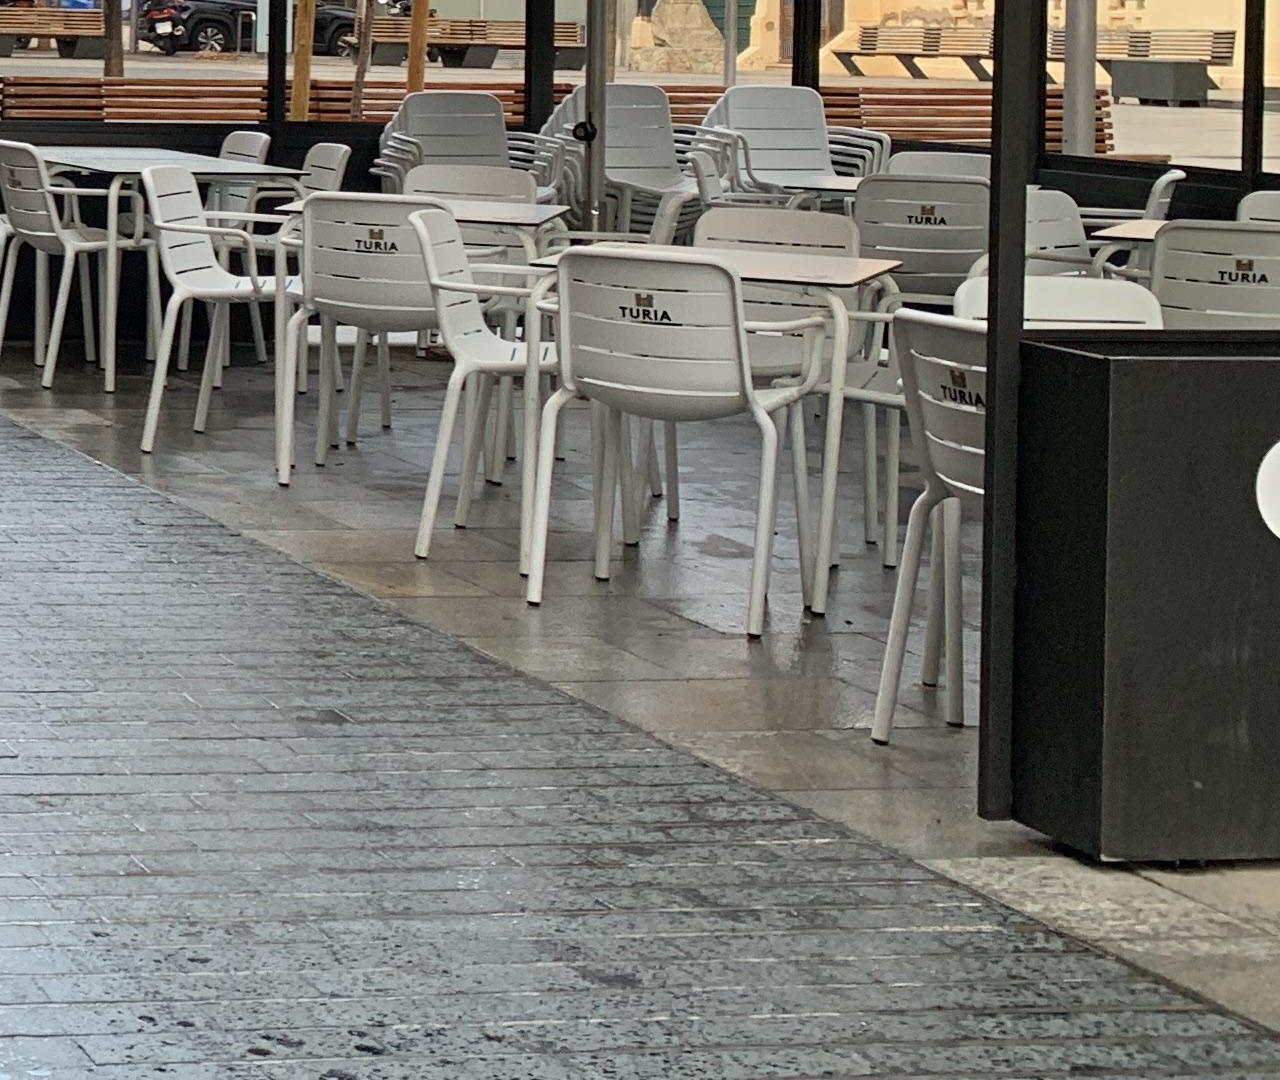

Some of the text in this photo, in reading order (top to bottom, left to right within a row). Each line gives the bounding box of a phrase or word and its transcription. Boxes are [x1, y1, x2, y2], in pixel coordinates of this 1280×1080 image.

[907, 215, 947, 226] TURIA
[354, 238, 399, 252] TURIA
[1217, 270, 1269, 284] TURIA
[619, 306, 672, 322] TURIA
[940, 384, 986, 408] TURIA
